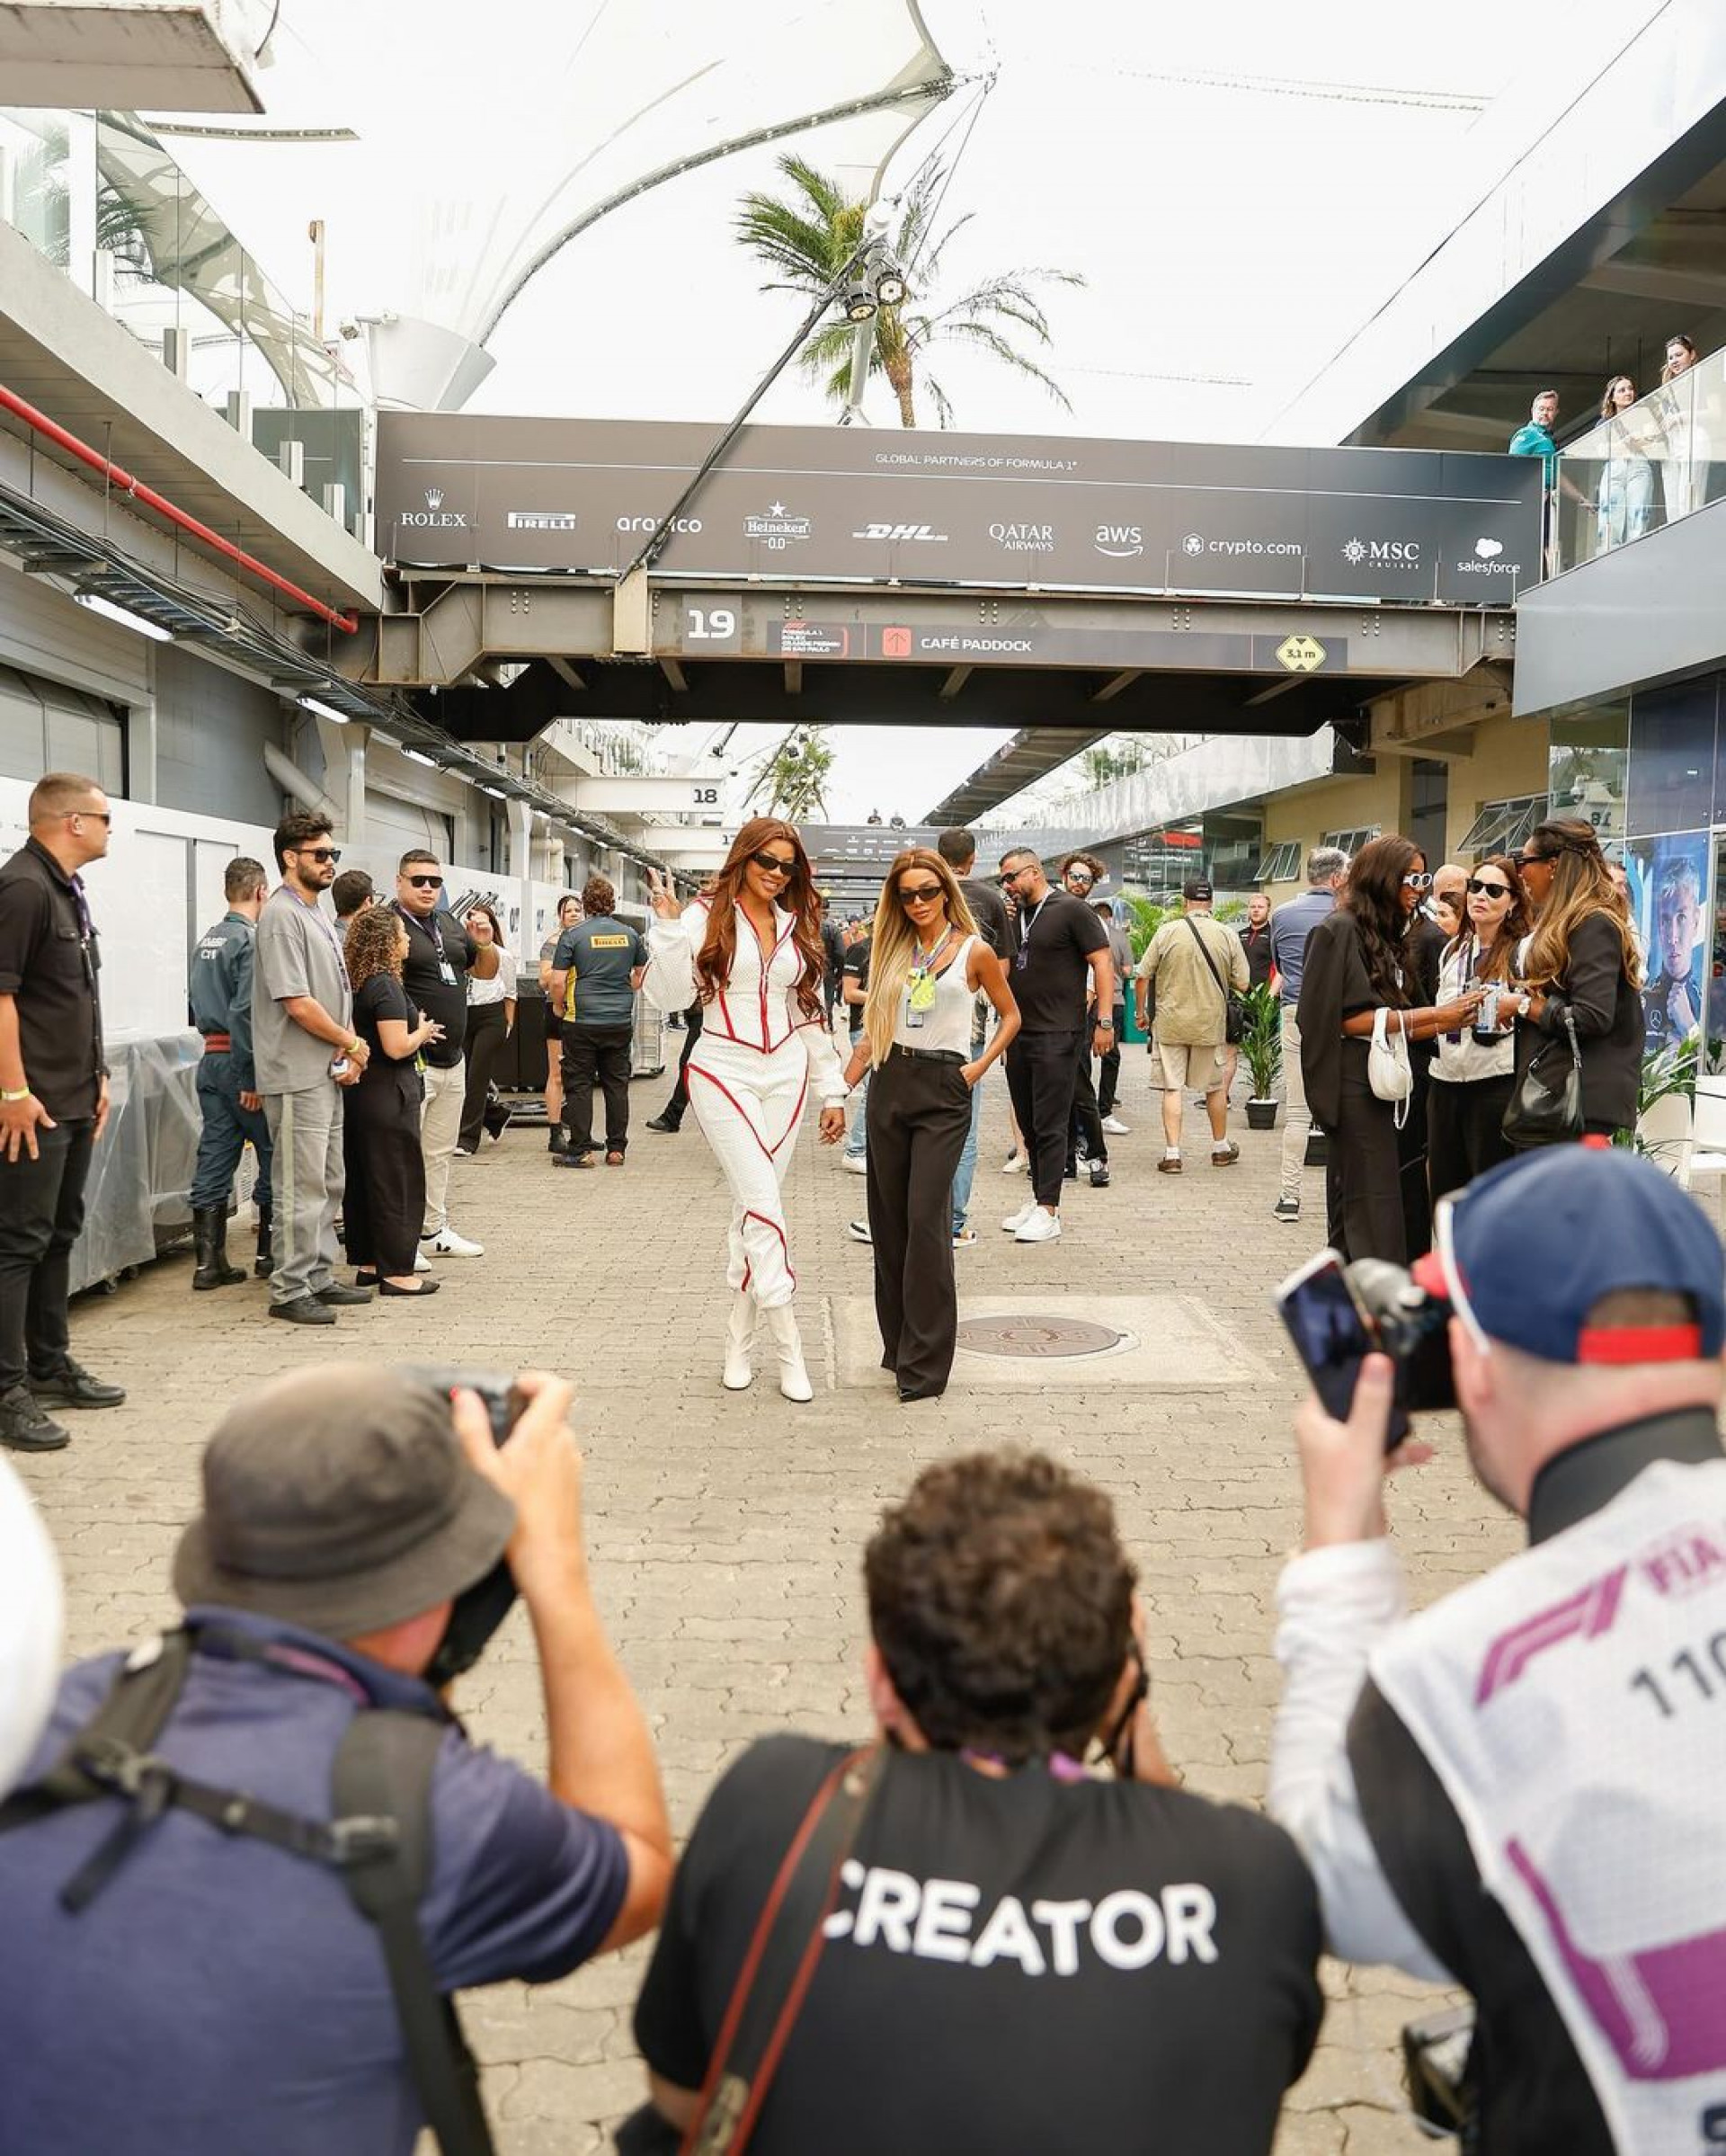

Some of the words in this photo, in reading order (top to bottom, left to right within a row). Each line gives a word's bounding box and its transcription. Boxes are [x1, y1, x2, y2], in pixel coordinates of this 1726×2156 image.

[875, 453, 921, 465] GLOBAL
[924, 455, 985, 468] PARTNERS
[987, 458, 1004, 468] OF
[1006, 459, 1064, 470] FORMULA
[401, 512, 467, 527] ROLEX
[508, 512, 576, 530] PIRELLI
[747, 520, 808, 534] Heineken
[865, 523, 936, 540] DHL
[988, 523, 1054, 543] QATAR
[1095, 525, 1143, 544] aws
[1003, 540, 1054, 552] AIRWAYS
[1209, 539, 1302, 556] crypto.com
[1369, 541, 1420, 560] MSC
[1456, 559, 1521, 576] salesforce
[688, 610, 735, 638] 19
[921, 635, 960, 650] CAFÉ
[963, 639, 1032, 652] PADDOCK
[694, 788, 718, 804] 18
